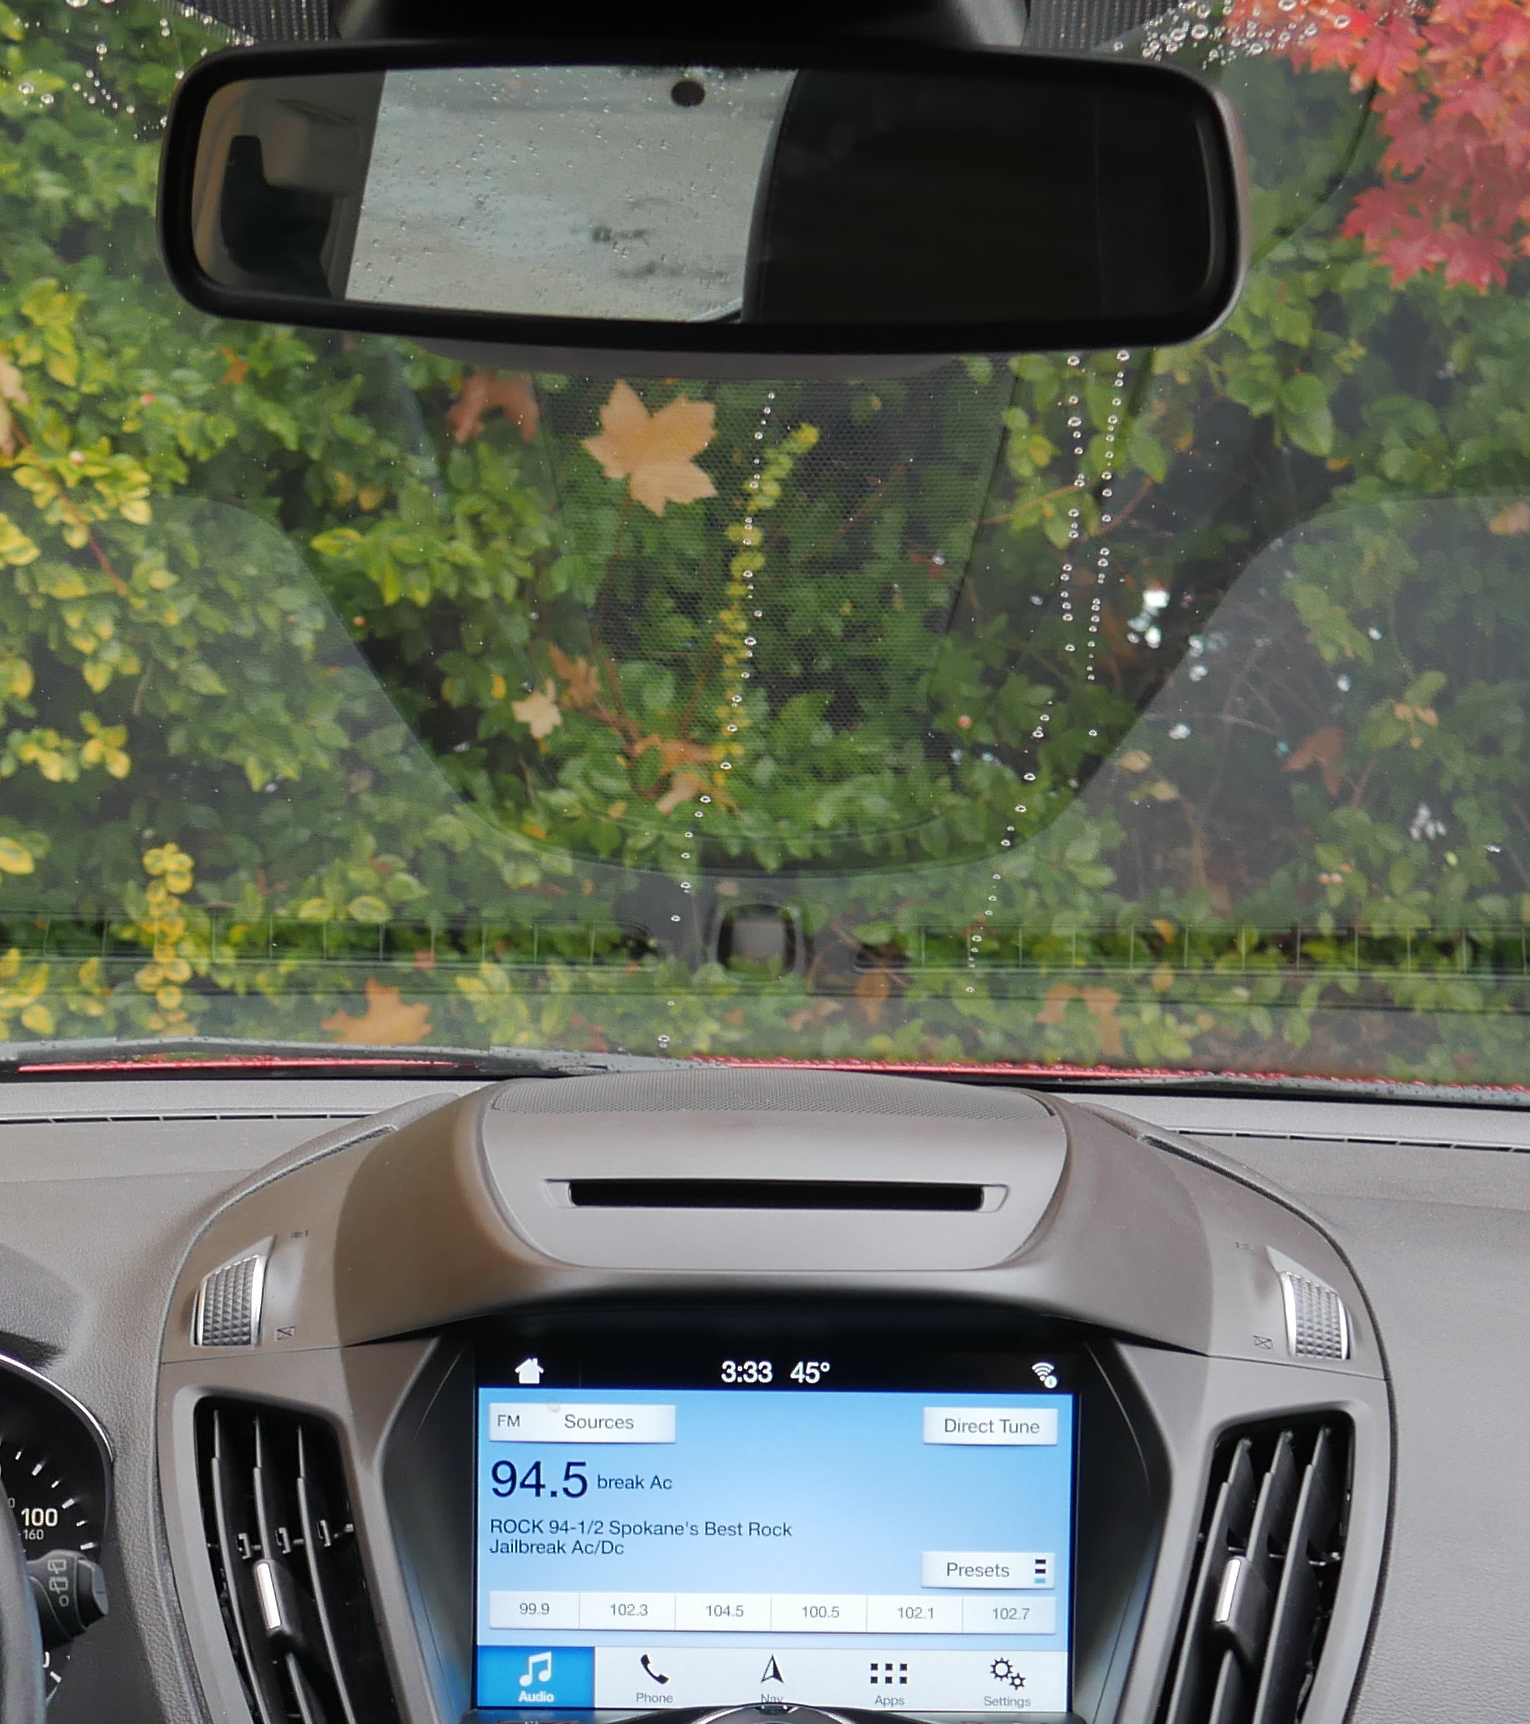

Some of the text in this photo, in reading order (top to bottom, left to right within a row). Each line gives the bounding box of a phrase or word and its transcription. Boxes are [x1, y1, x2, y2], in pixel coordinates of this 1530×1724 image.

[720, 1361, 831, 1384] 3:33 45°
[496, 1414, 521, 1429] FM
[563, 1413, 635, 1431] Sources
[943, 1417, 1041, 1436] Direct Tune
[489, 1459, 673, 1500] 94.5 break Ac
[20, 1507, 59, 1528] 100
[23, 1528, 45, 1541] 160
[489, 1518, 794, 1540] ROCK 94-1/2 Spokane's Best Rock
[489, 1538, 626, 1557] Jailbreak Ac/Dc
[945, 1561, 1011, 1580] Presets
[518, 1602, 551, 1617] 99.9
[609, 1603, 649, 1618] 102.3
[704, 1604, 745, 1619] 104.5
[800, 1605, 841, 1620] 100.5
[896, 1606, 936, 1621] 102.1
[991, 1607, 1031, 1622] 102.7
[518, 1690, 555, 1704] Audio
[635, 1692, 675, 1705] Phone
[760, 1693, 784, 1703] Nav
[874, 1694, 906, 1709] Apps
[983, 1695, 1032, 1710] Settings
